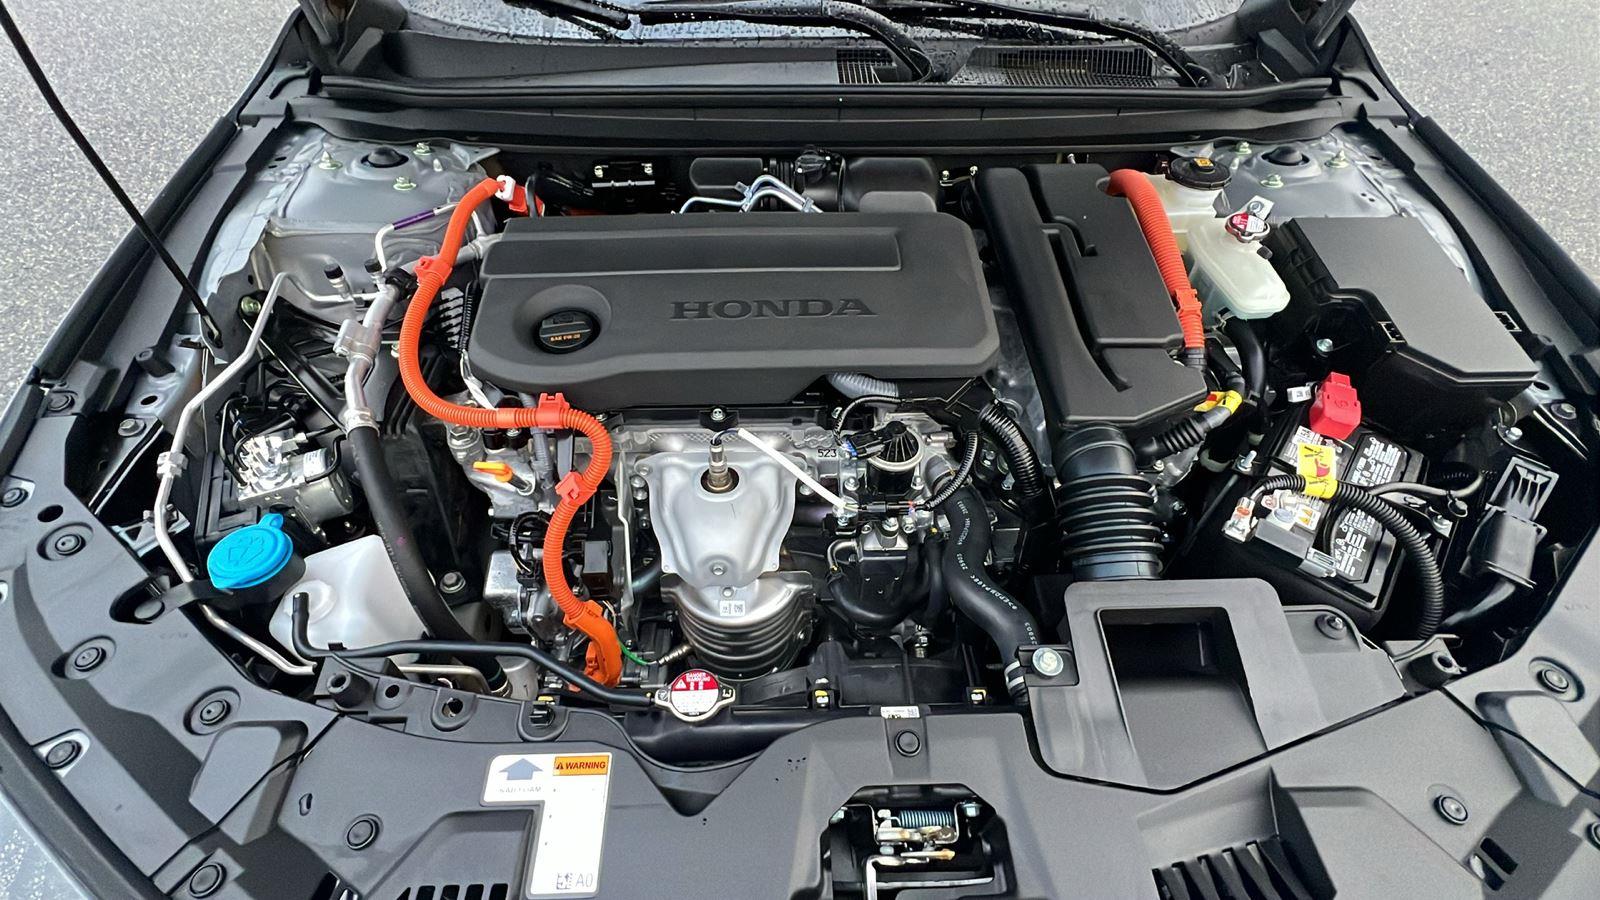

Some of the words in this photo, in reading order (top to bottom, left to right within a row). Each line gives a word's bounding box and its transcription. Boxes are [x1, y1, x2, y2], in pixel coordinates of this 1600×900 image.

[670, 299, 879, 320] HONDA
[817, 448, 837, 458] 523
[565, 761, 606, 770] WARNING
